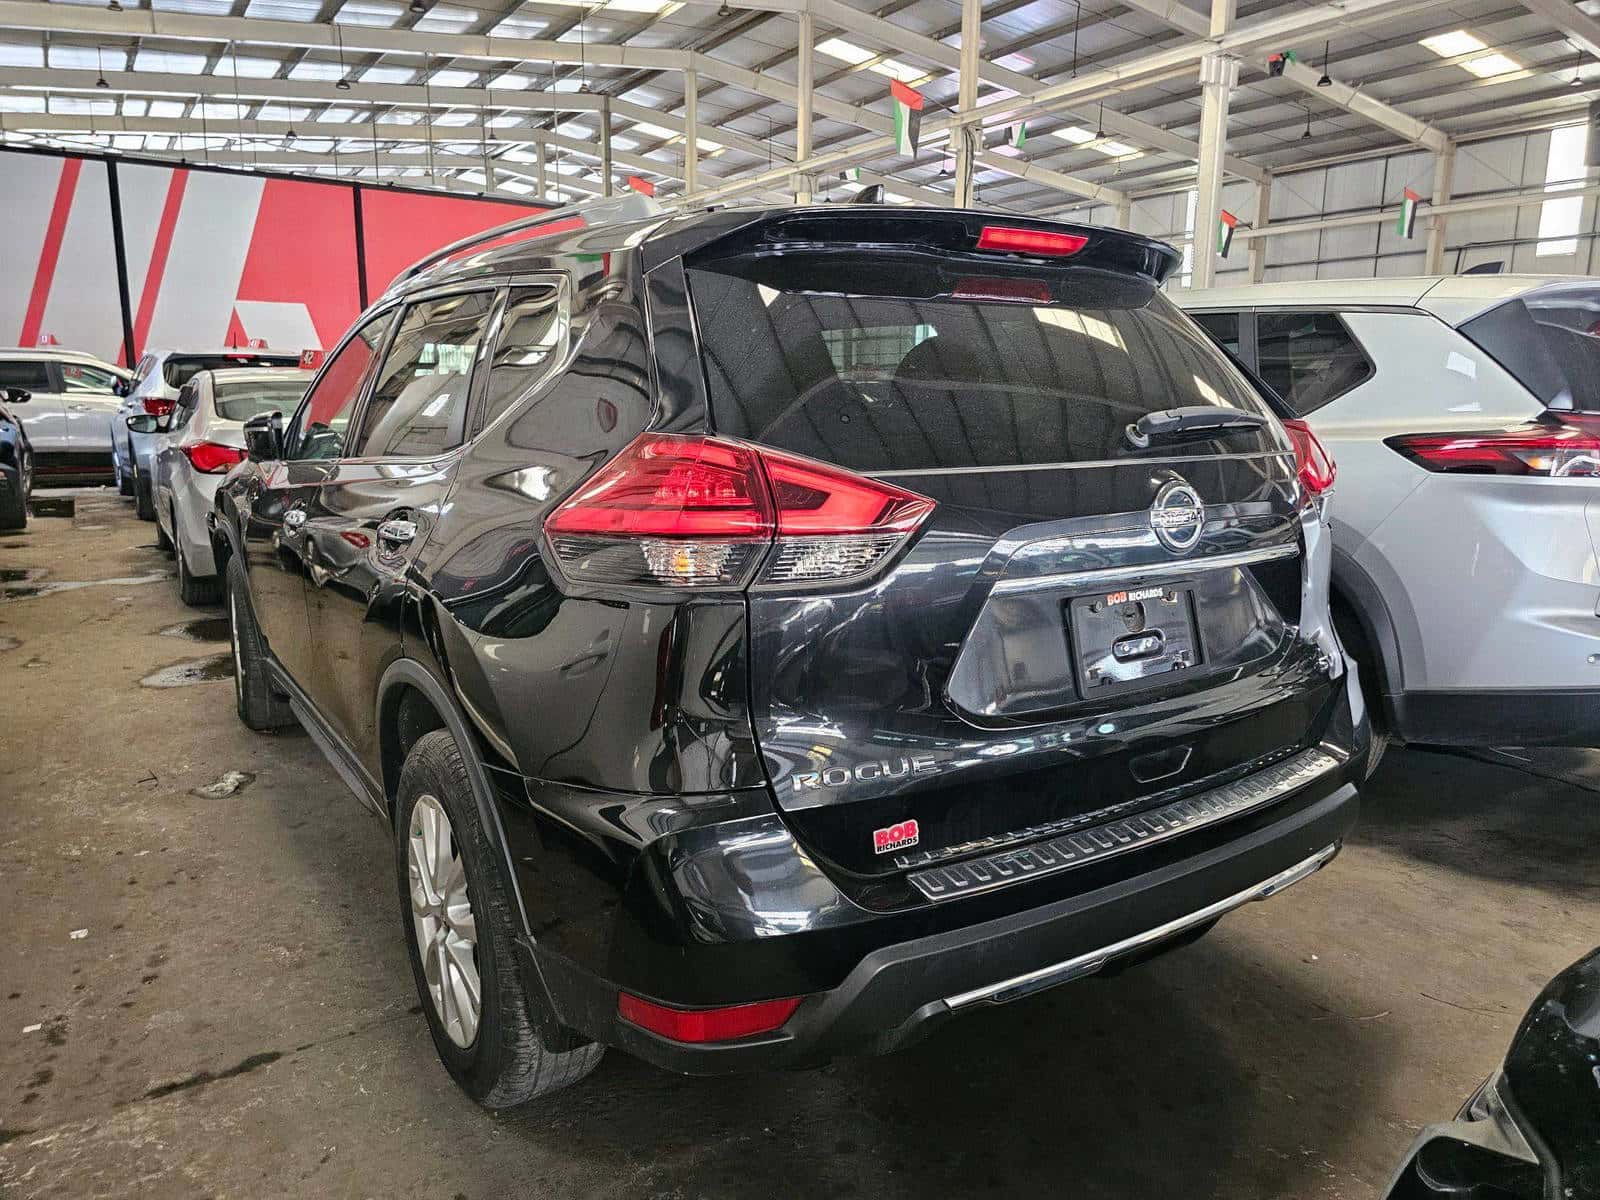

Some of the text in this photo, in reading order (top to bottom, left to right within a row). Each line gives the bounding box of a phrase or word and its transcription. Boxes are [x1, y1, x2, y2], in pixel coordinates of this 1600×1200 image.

[304, 351, 314, 365] 42
[1161, 510, 1203, 524] NISSAN
[1106, 588, 1163, 606] BOB RICHARDS
[791, 755, 942, 792] ROGUE
[875, 822, 918, 846] BOB
[876, 836, 918, 853] RICHARDS
